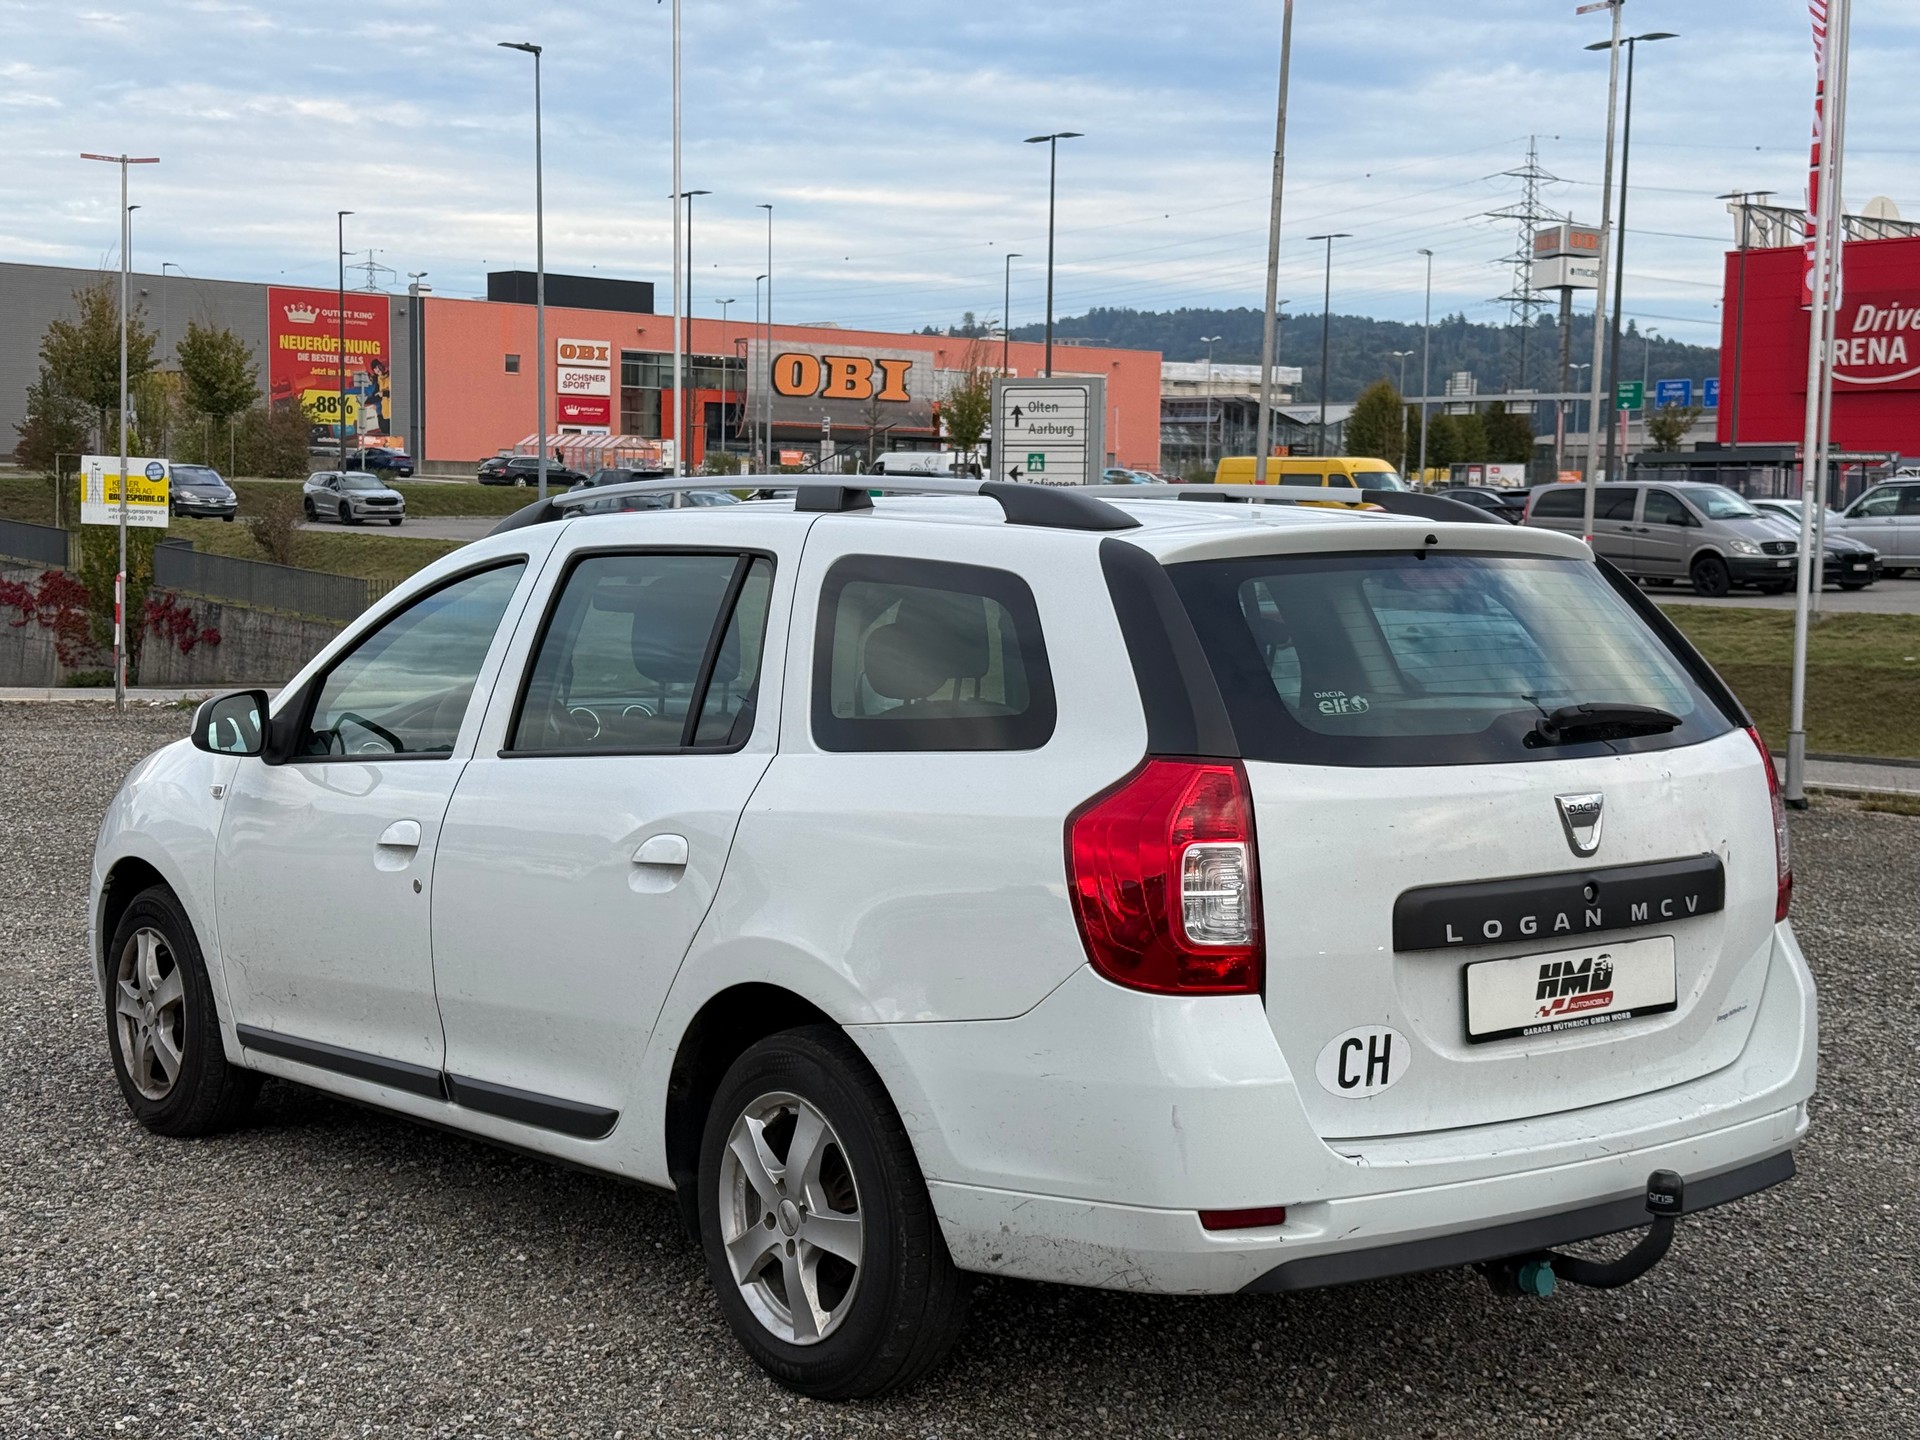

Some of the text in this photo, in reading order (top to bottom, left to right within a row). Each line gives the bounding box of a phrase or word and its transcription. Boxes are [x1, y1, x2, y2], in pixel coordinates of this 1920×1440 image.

[1569, 231, 1600, 250] OB
[1852, 301, 1920, 333] Drive
[297, 352, 310, 362] DIE
[311, 354, 339, 363] BESTEN
[560, 343, 609, 361] OBI
[310, 367, 327, 376] Jetzt
[565, 372, 606, 383] OCHSNER
[773, 352, 913, 402] OBI
[562, 381, 591, 390] SPORT
[1028, 400, 1059, 413] Olten
[1028, 422, 1075, 437] Aarburg
[1313, 690, 1346, 699] DACIA
[1318, 697, 1350, 714] elf
[1569, 802, 1600, 813] DACIA
[1446, 894, 1699, 942] LOGAN MCV
[1569, 997, 1611, 1010] AUTOMOBILE
[1523, 1024, 1552, 1036] GARAGE
[1552, 1018, 1589, 1031] WÜTHRICH
[1611, 1011, 1632, 1022] WORB
[1337, 1033, 1392, 1089] CH
